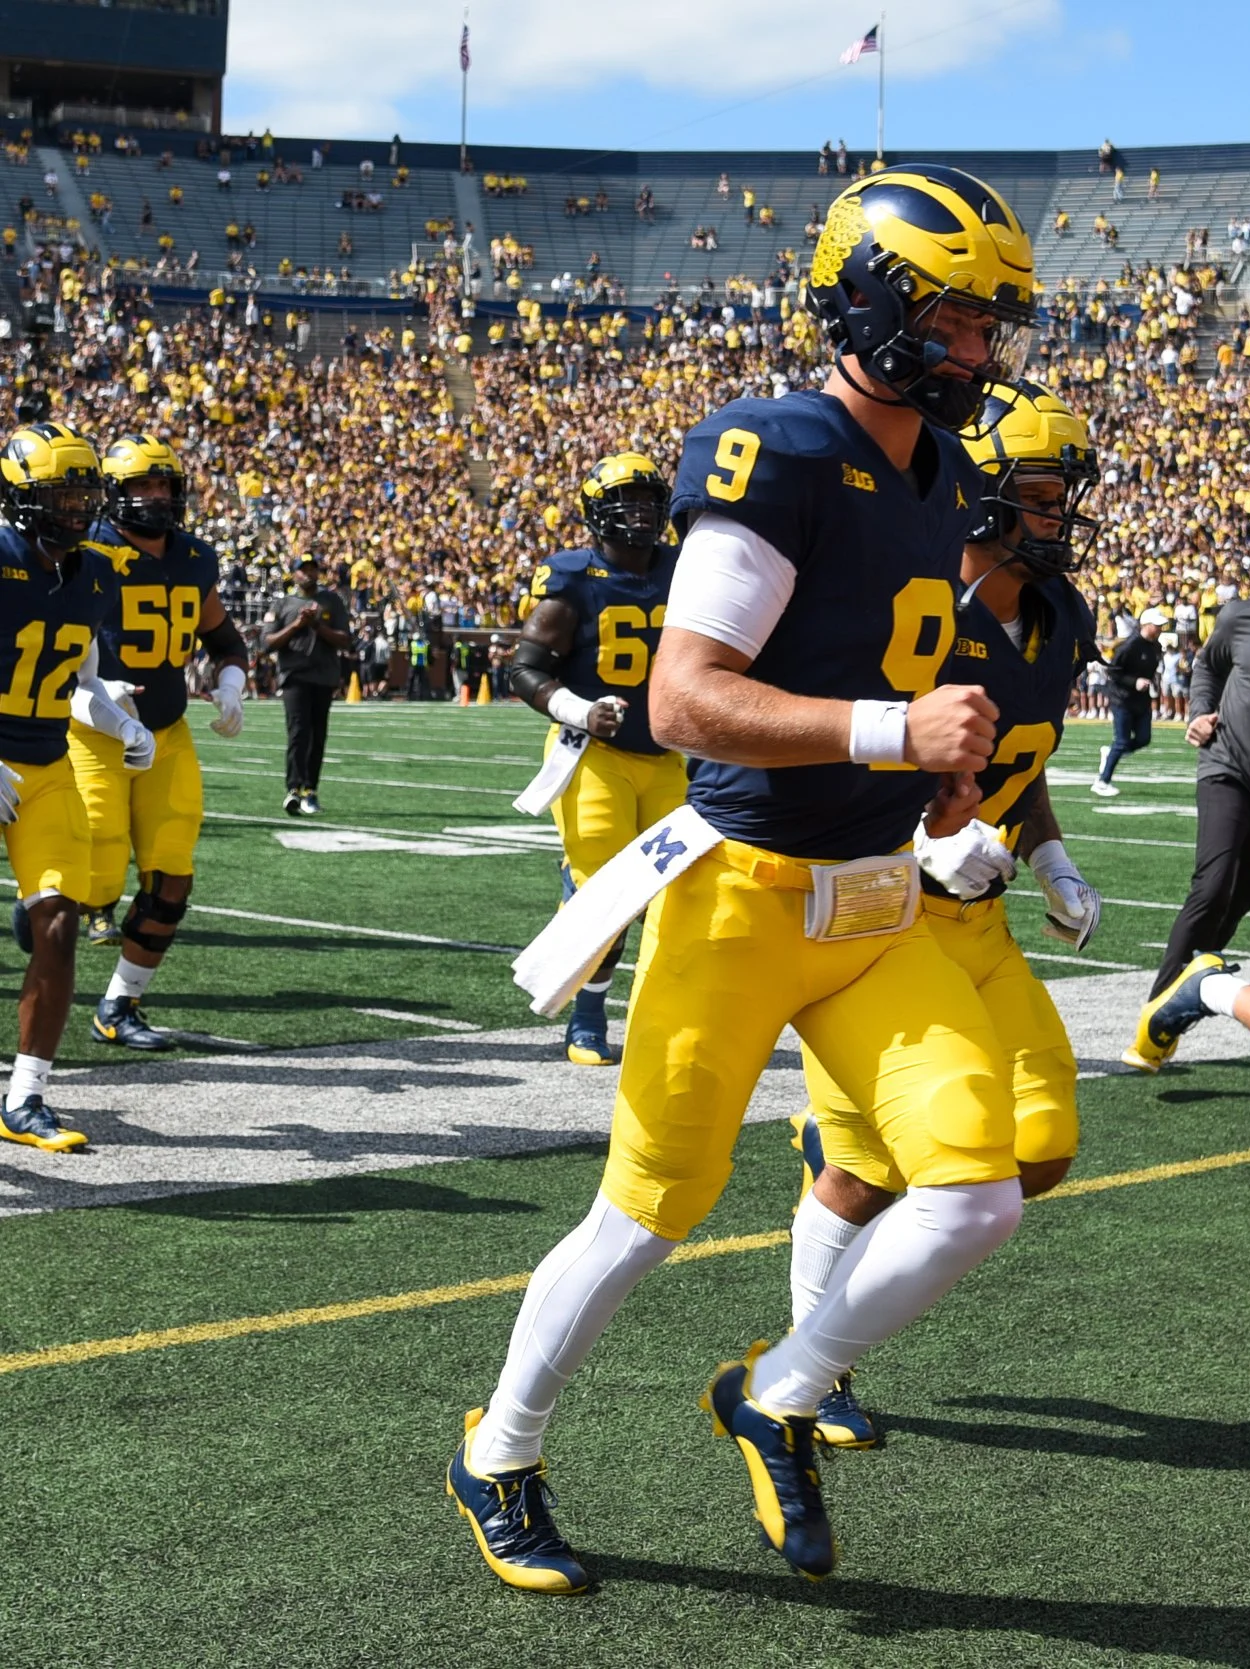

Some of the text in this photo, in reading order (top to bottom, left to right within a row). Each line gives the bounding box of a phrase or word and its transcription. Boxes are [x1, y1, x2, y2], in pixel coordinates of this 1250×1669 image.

[706, 428, 761, 502] 9
[120, 584, 200, 669] 58
[0, 619, 92, 718] 12
[560, 729, 587, 749] M
[640, 826, 688, 875] M
